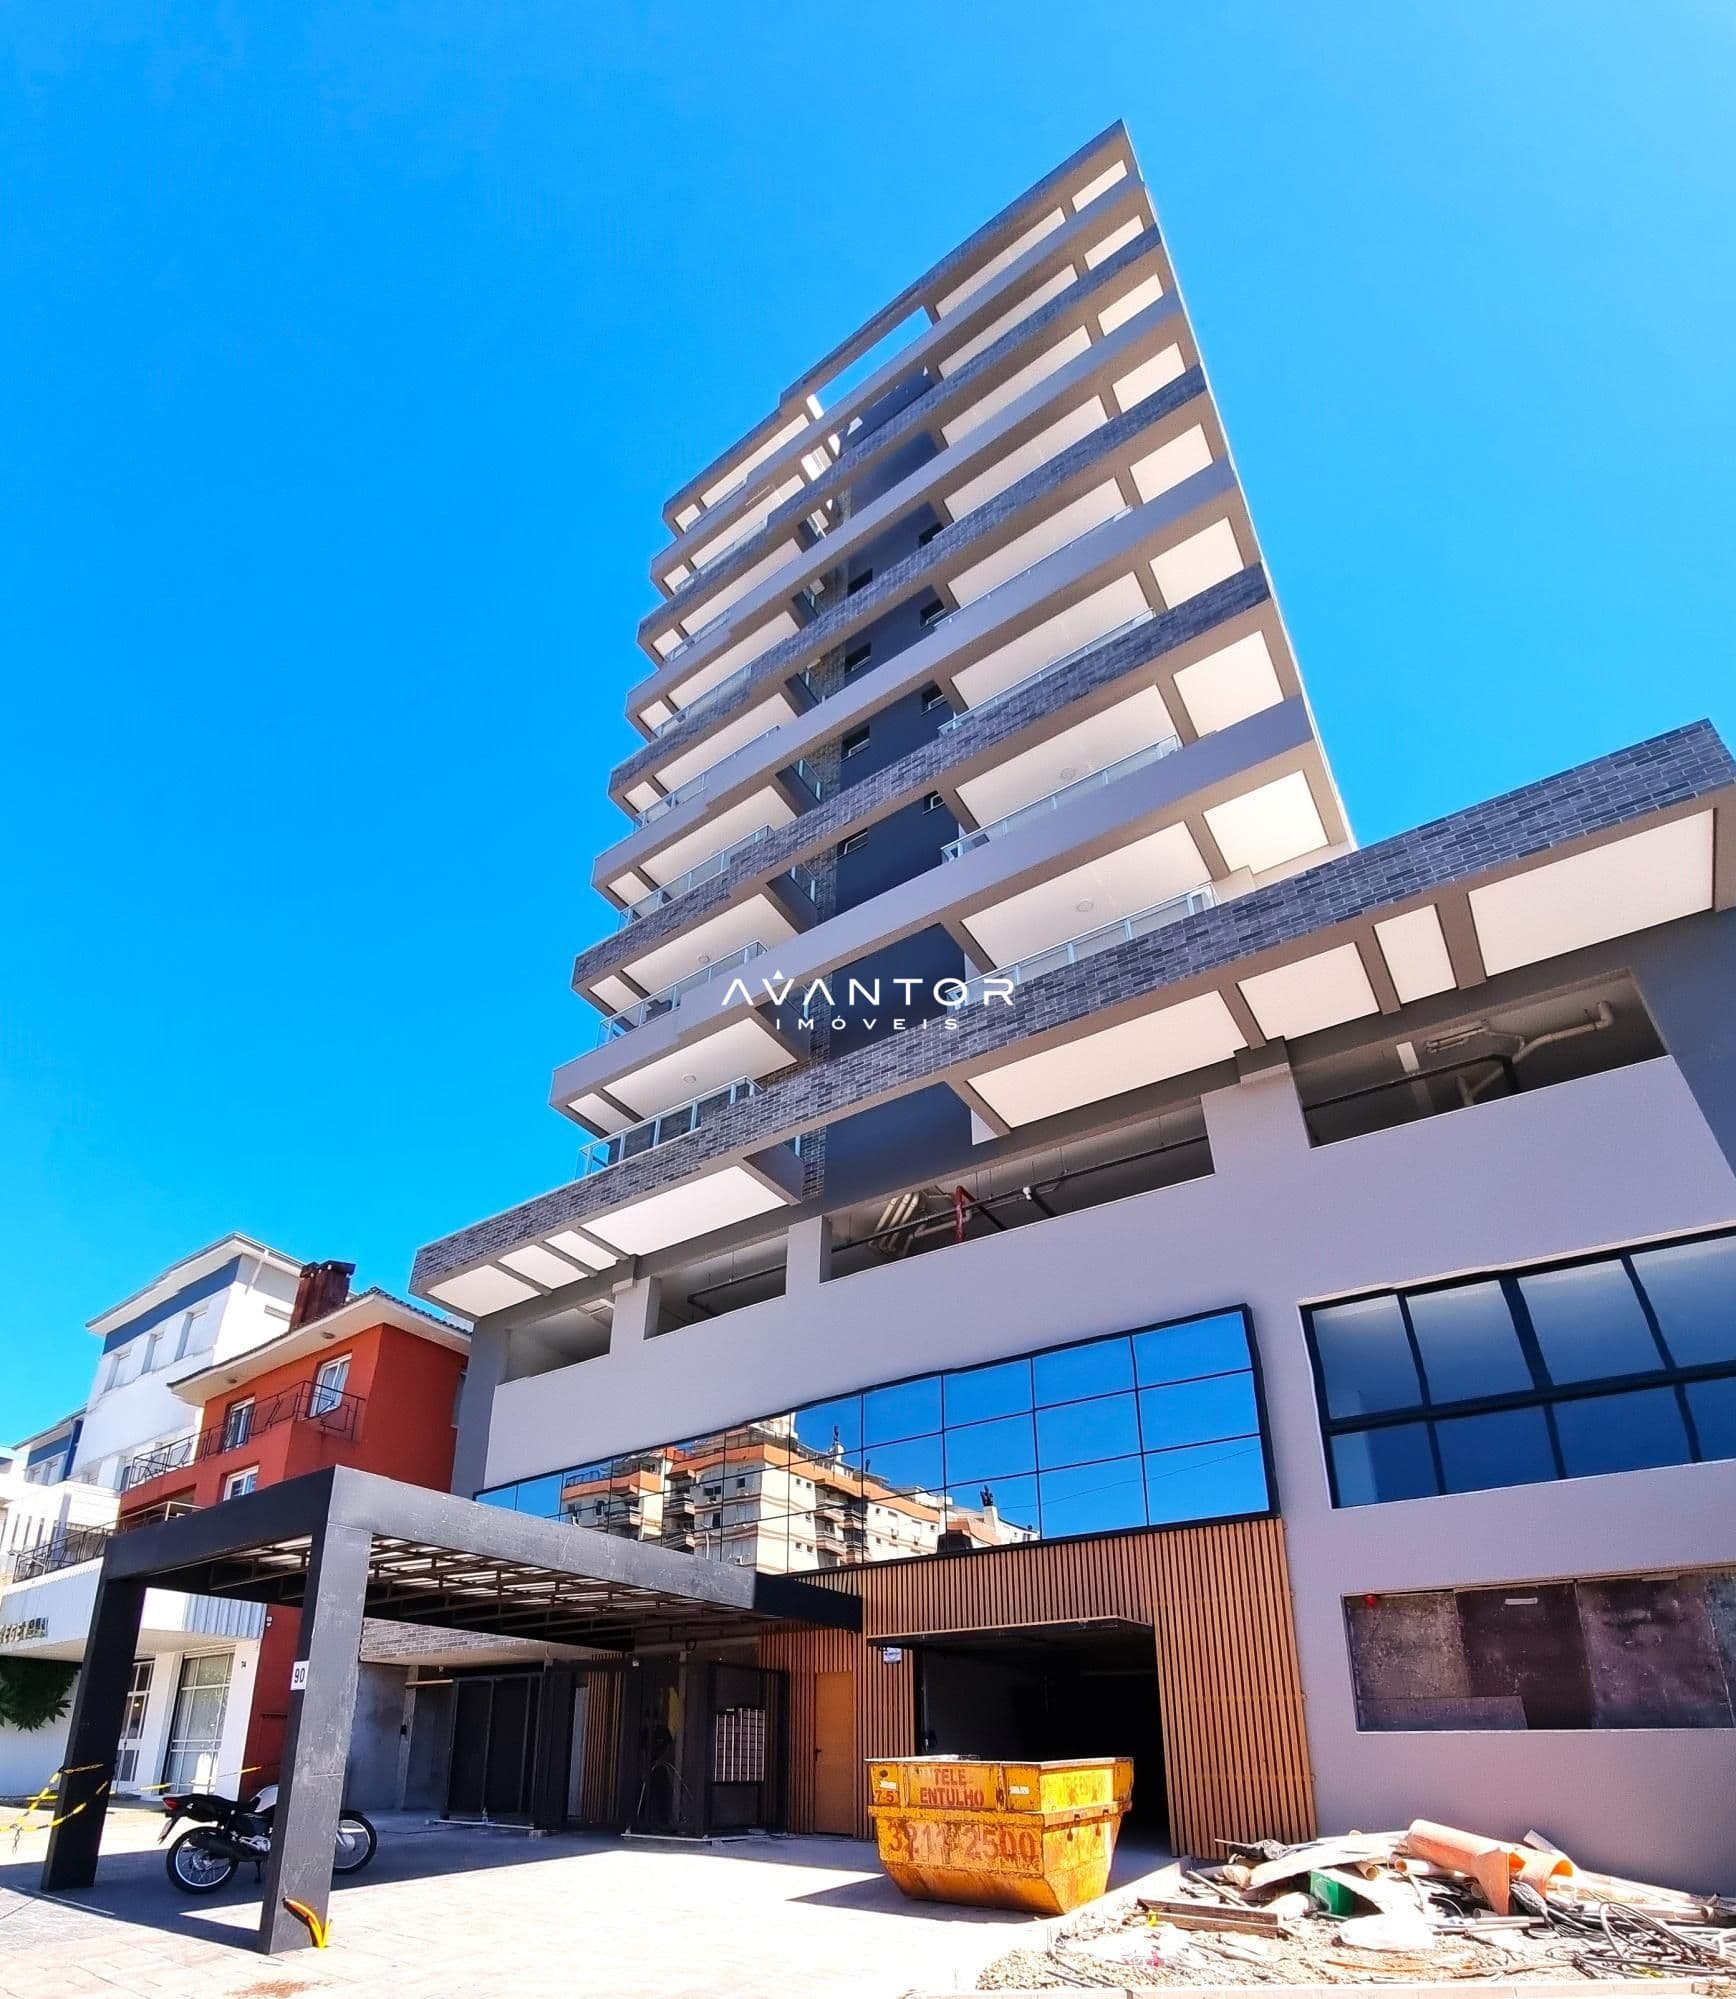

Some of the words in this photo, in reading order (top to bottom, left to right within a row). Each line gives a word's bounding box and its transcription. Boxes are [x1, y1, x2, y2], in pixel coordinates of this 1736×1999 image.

[294, 1667, 305, 1683] 90
[934, 1768, 967, 1786] TELE
[919, 1786, 985, 1807] ENTULHO
